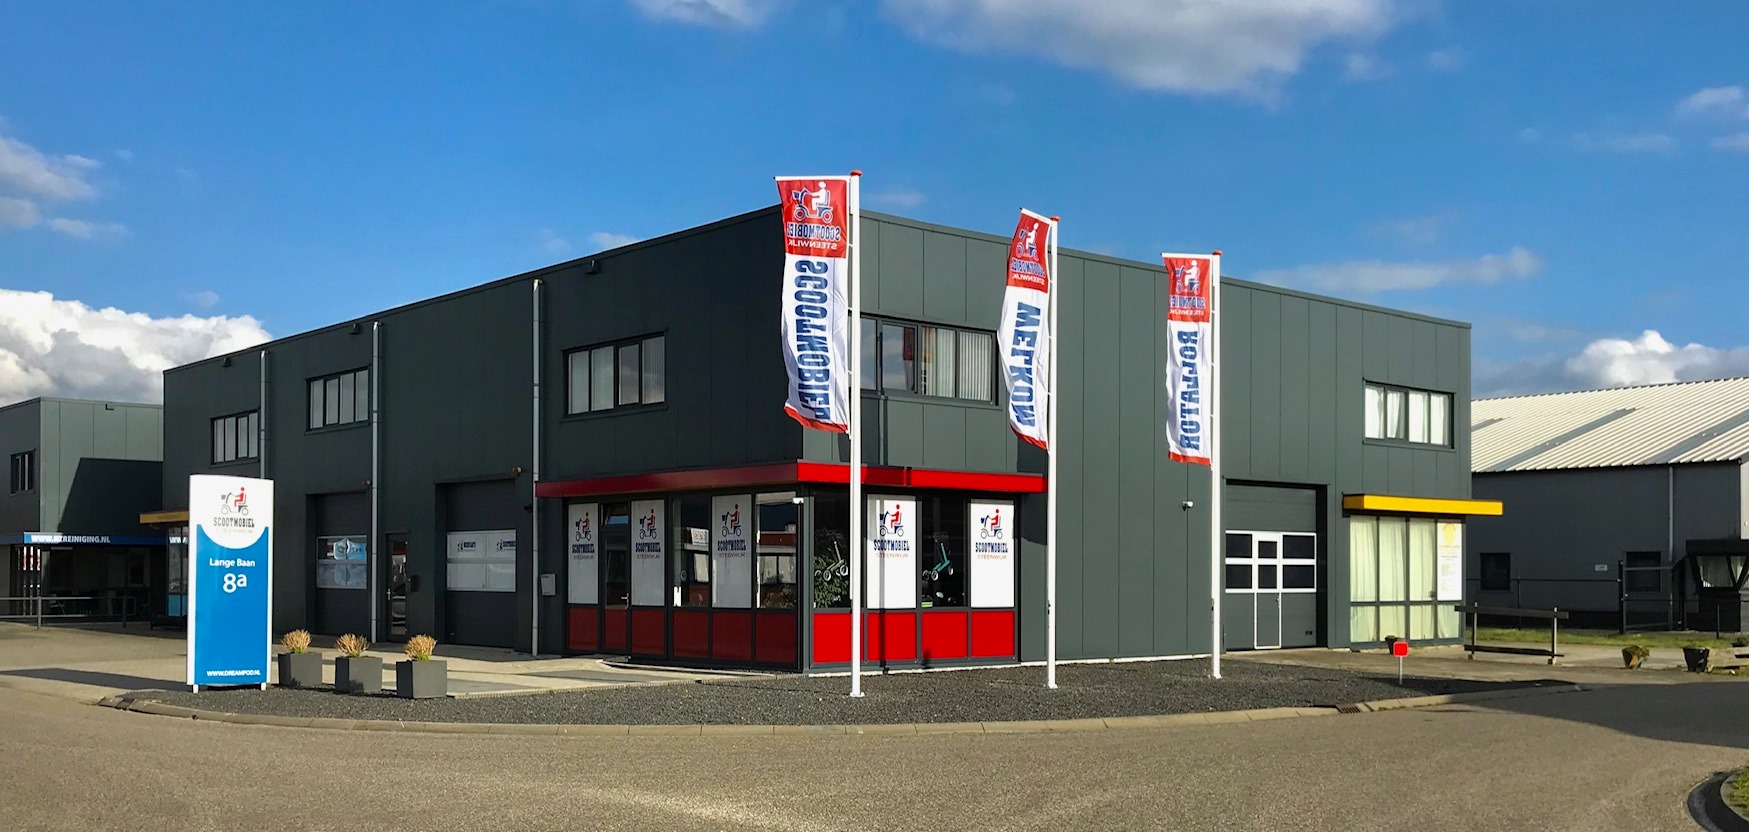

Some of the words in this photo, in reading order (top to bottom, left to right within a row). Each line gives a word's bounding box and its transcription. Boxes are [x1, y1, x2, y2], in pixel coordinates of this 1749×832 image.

[213, 517, 255, 528] SCOOTMOBIEL
[873, 539, 910, 551] SCOOTMOBIEL
[975, 542, 1008, 553] SCOOTMOBIEL
[209, 558, 236, 569] Lange
[237, 558, 256, 567] Baan
[223, 573, 247, 593] 8a
